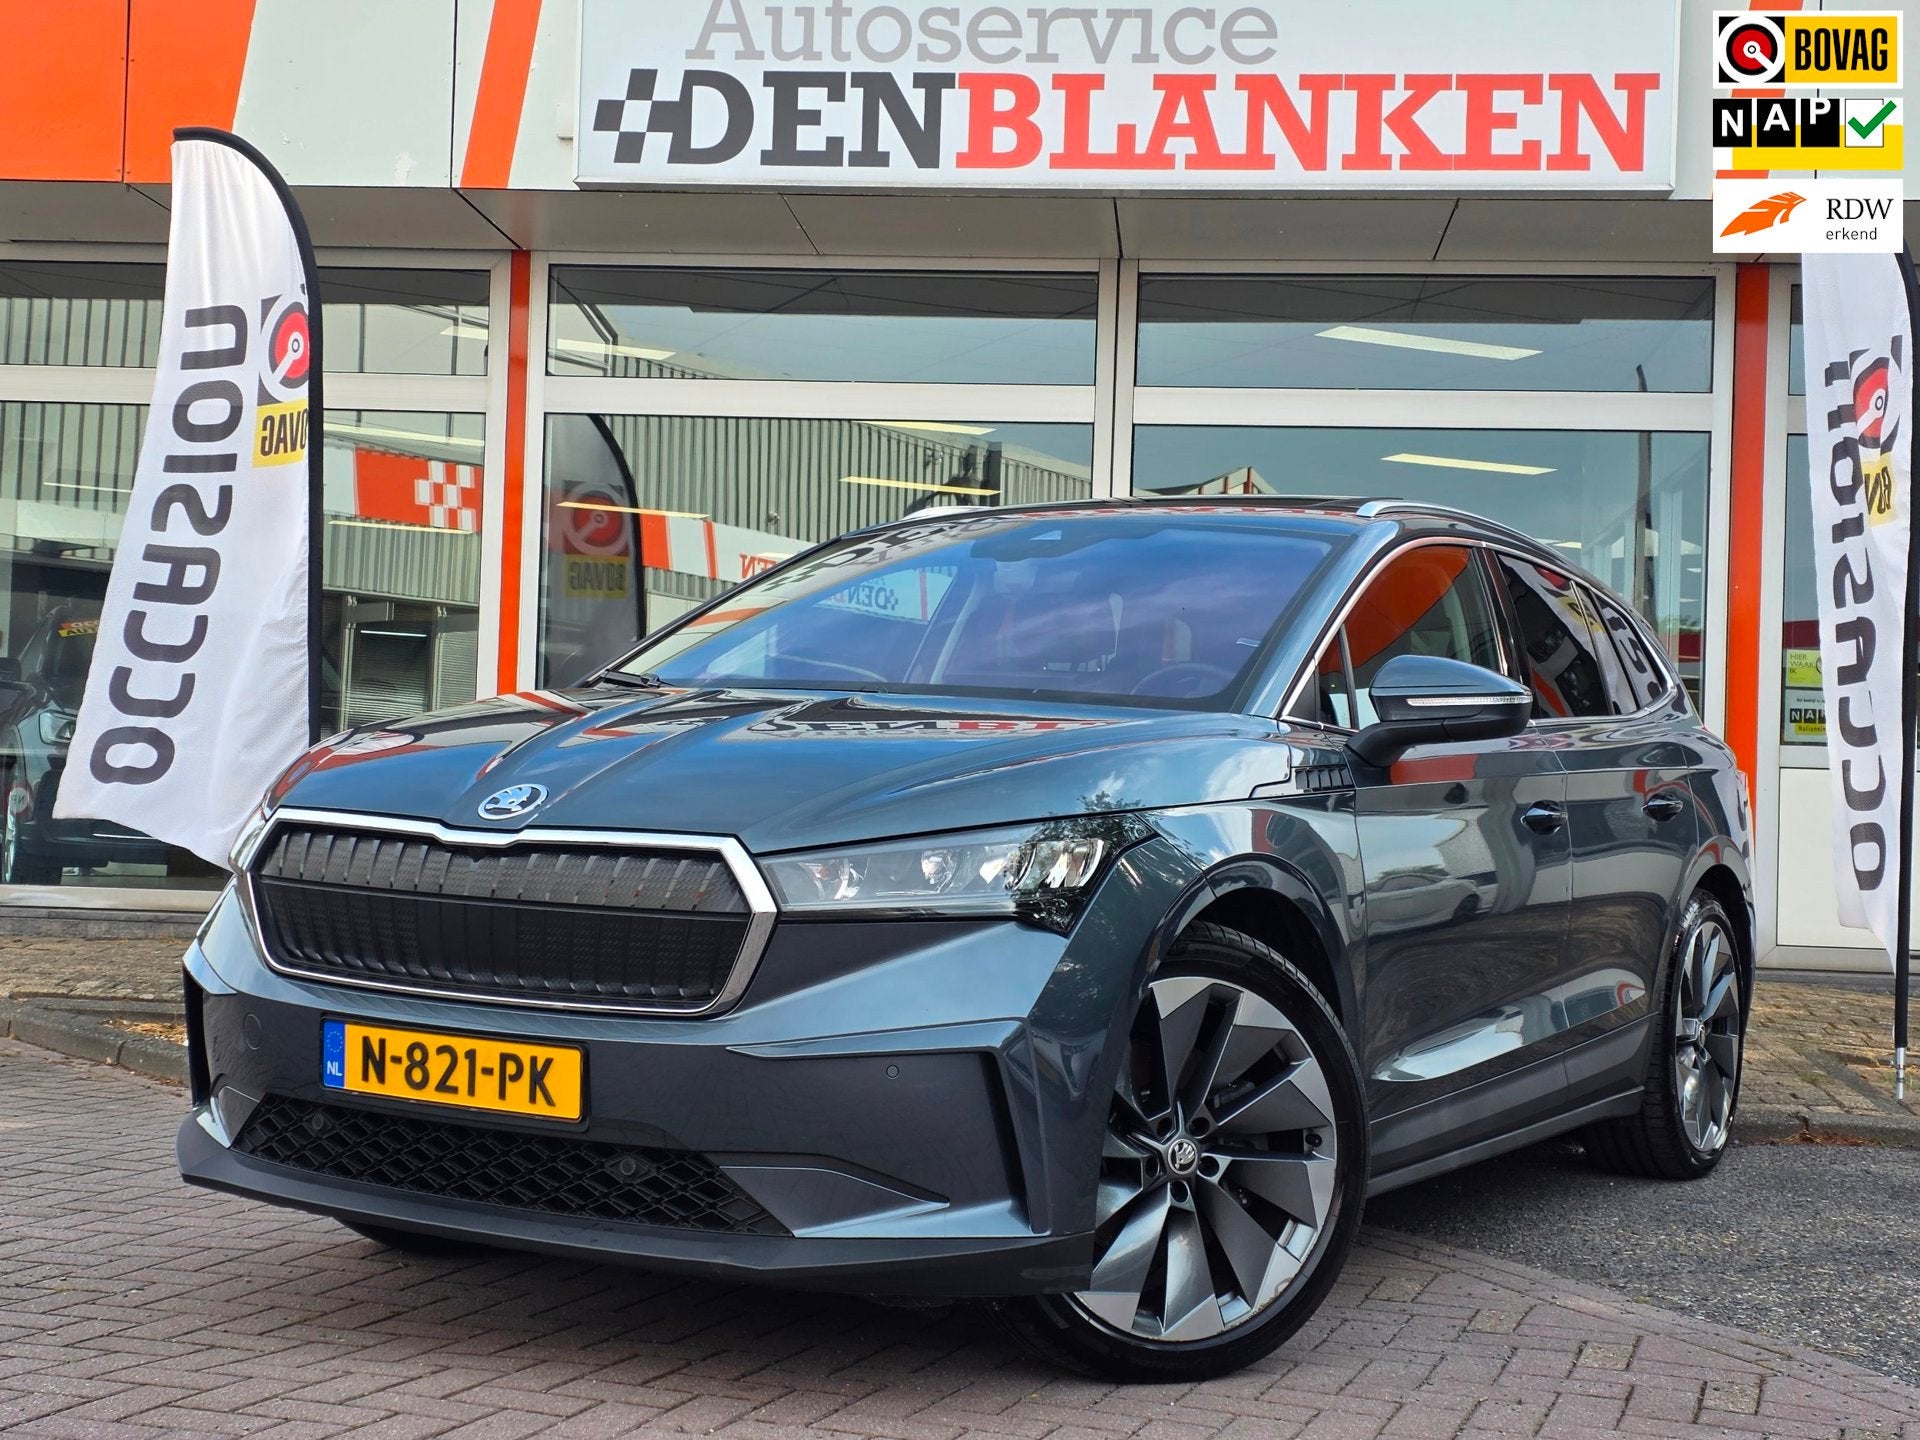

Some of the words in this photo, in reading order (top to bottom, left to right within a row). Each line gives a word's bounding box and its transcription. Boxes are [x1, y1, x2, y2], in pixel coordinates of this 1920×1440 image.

[685, 0, 1277, 64] Autoservice
[326, 1060, 342, 1077] NL
[361, 1035, 556, 1107] N-821-PK
